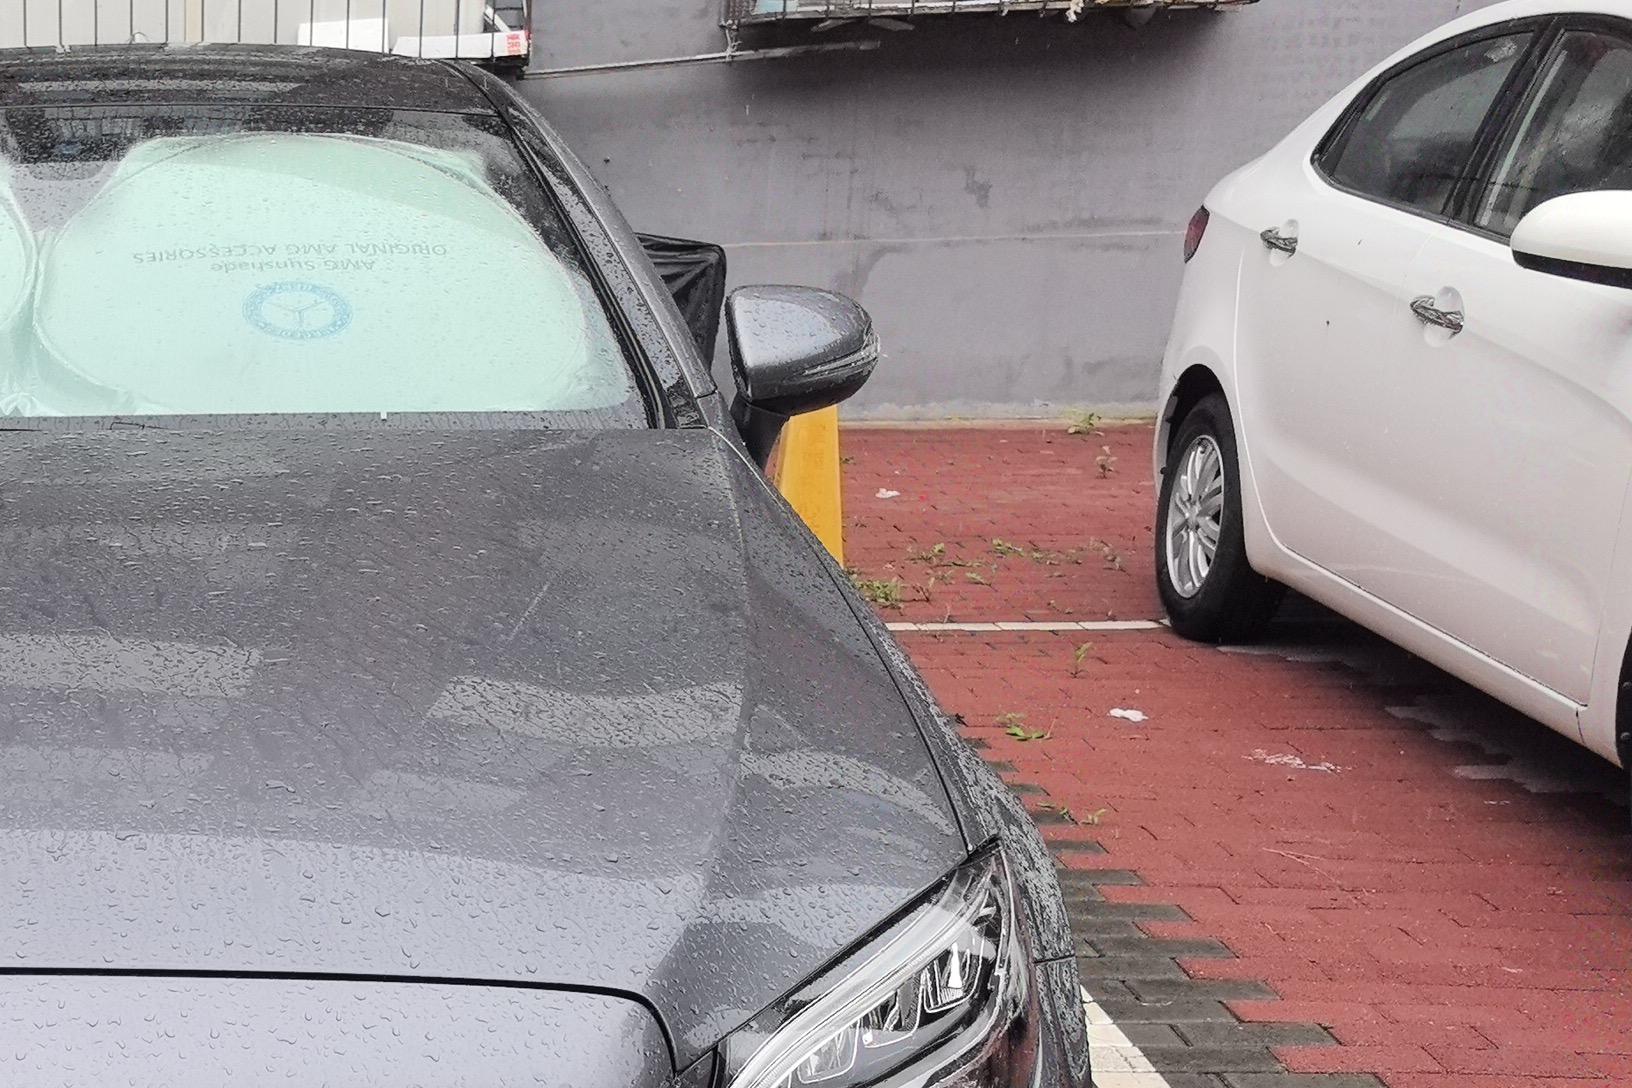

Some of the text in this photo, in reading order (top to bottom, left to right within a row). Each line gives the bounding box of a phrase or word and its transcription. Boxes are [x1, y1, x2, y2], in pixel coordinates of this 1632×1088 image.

[132, 243, 448, 264] ORIGINAL AMG ACCESSORIES
[209, 257, 376, 275] AMG Sunshade
